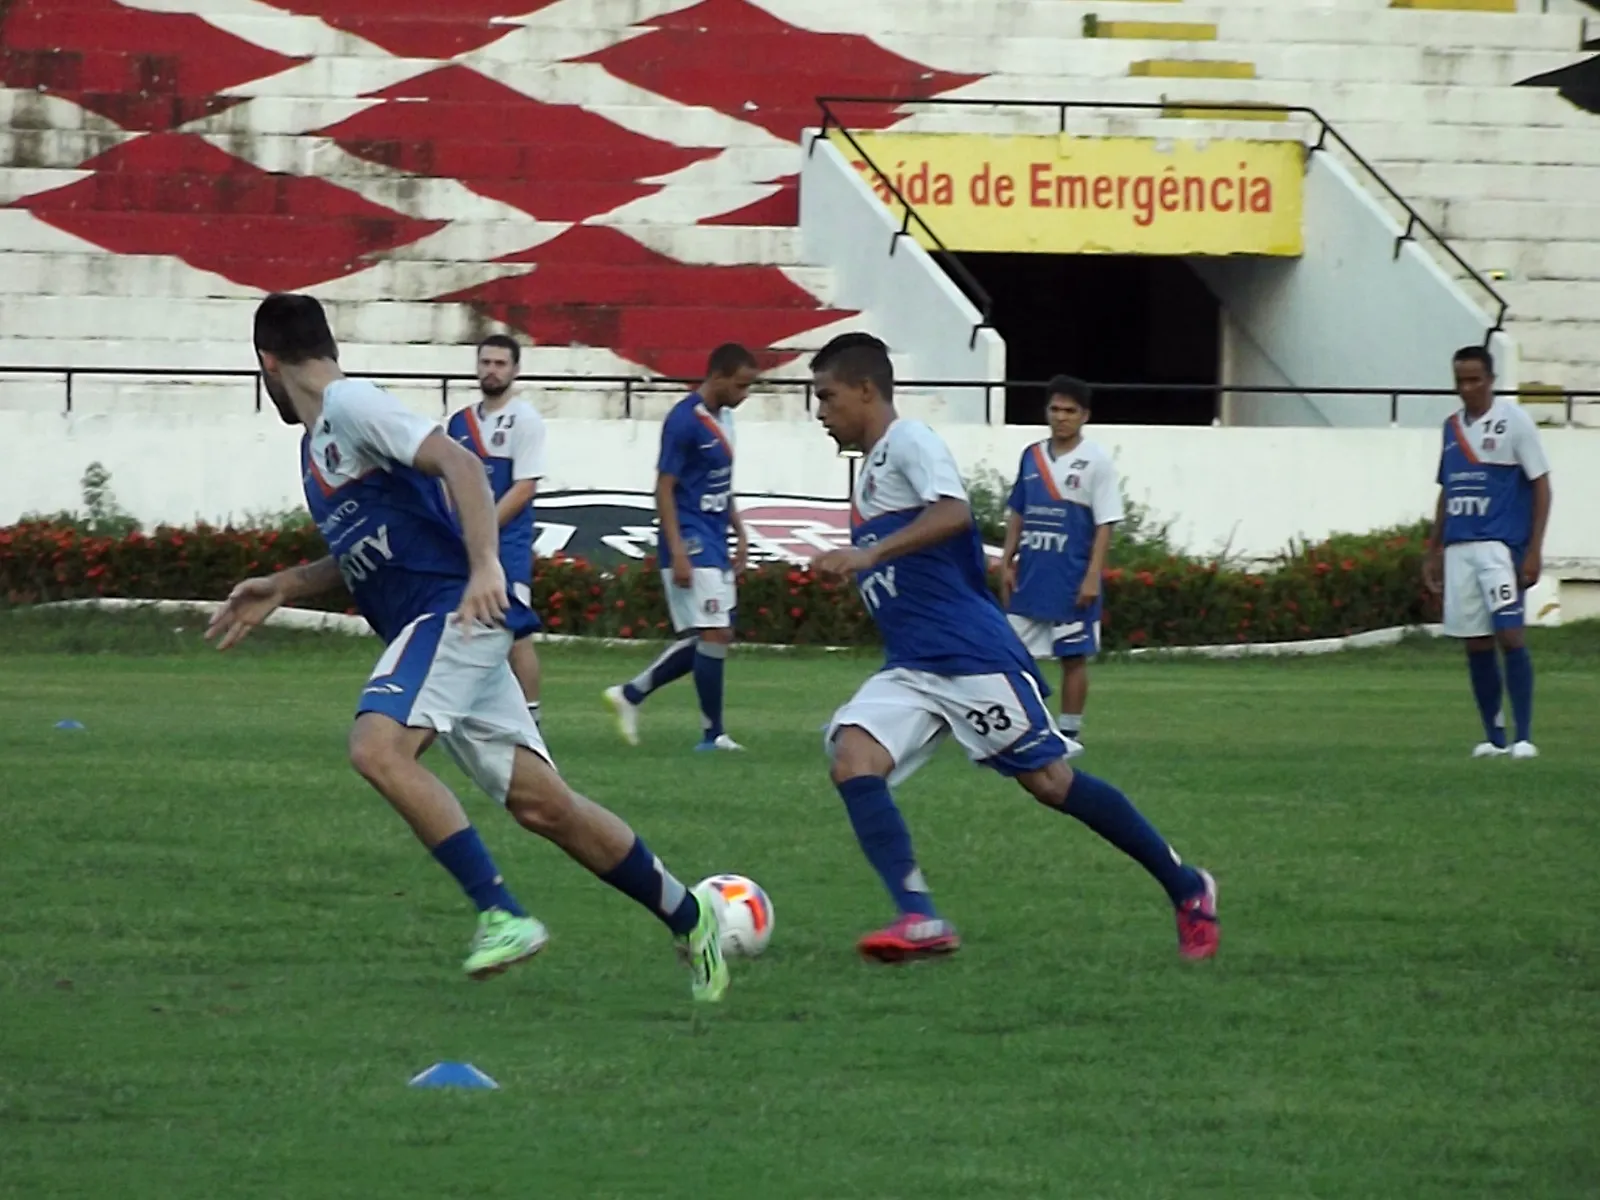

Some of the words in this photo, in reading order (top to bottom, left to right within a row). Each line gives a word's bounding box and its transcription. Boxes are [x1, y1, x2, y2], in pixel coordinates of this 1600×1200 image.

[851, 160, 953, 206] aída
[969, 162, 1015, 207] de
[1030, 161, 1272, 227] Emergência
[1482, 419, 1508, 434] 16
[1446, 496, 1492, 516] OTY
[1489, 584, 1512, 603] 16
[966, 704, 1012, 736] 33
